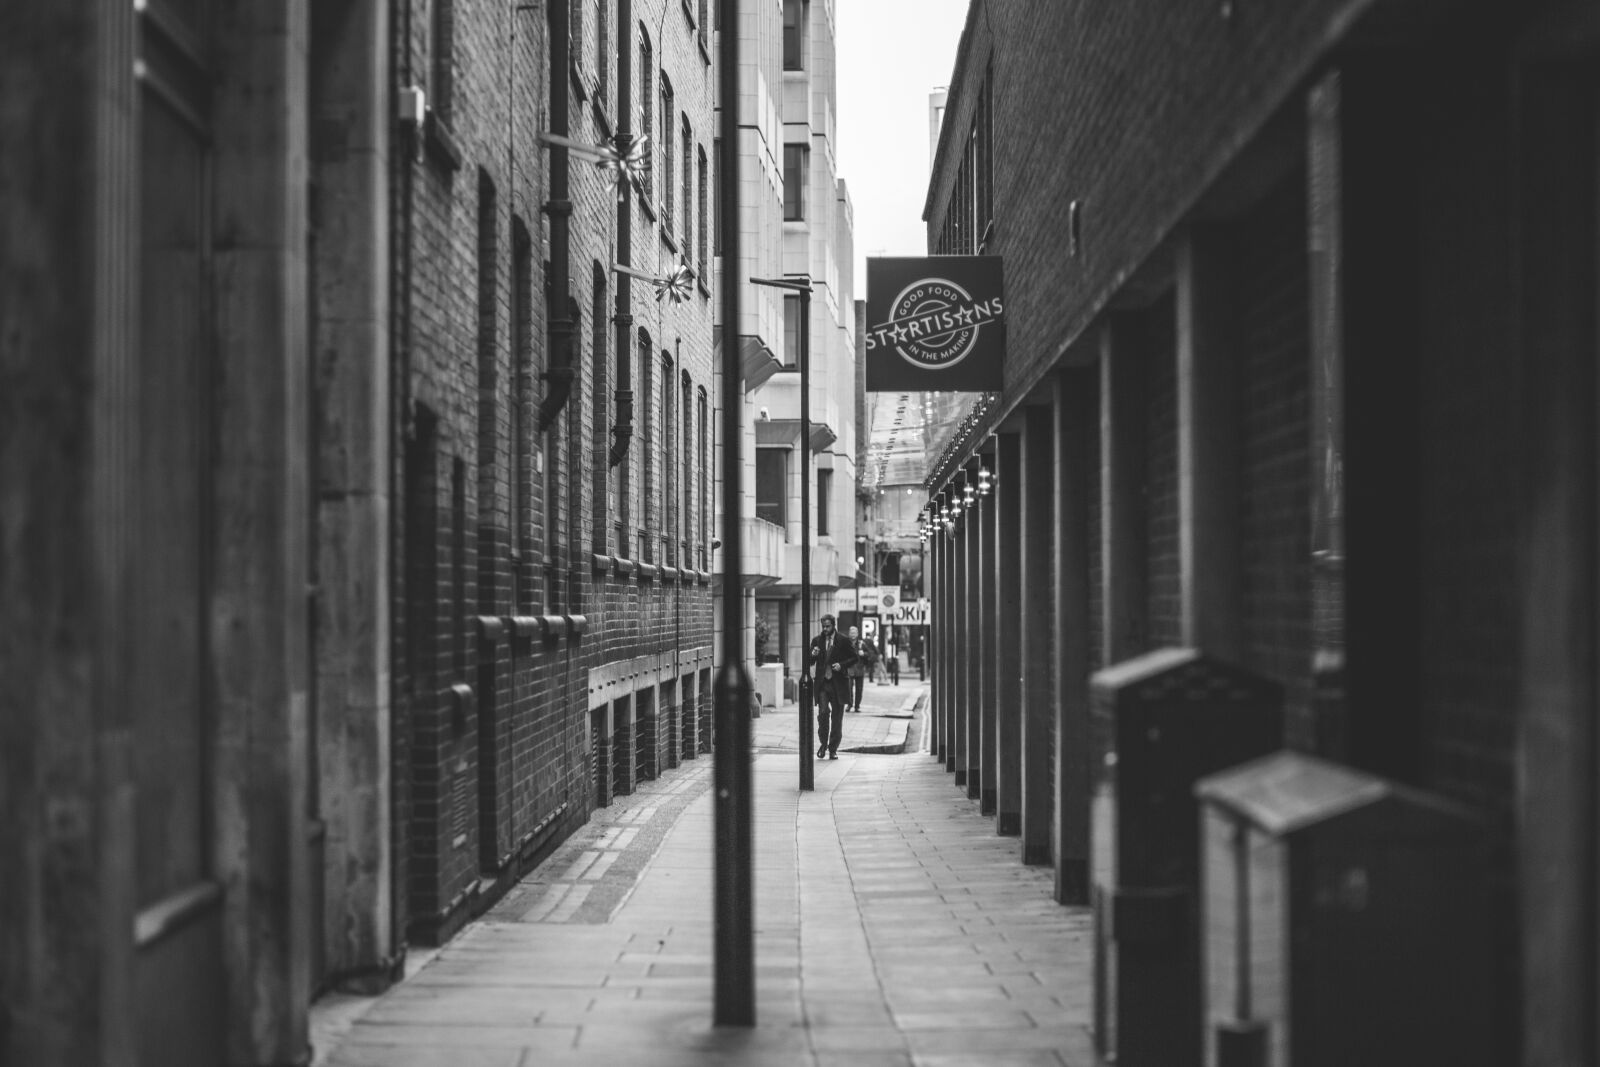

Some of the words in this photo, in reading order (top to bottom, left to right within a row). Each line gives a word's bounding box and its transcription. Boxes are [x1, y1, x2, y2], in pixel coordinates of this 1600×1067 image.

[899, 289, 924, 316] GOOD
[928, 286, 958, 301] FOOD
[908, 344, 920, 355] IN
[921, 350, 938, 361] THE
[940, 330, 969, 359] MAKING
